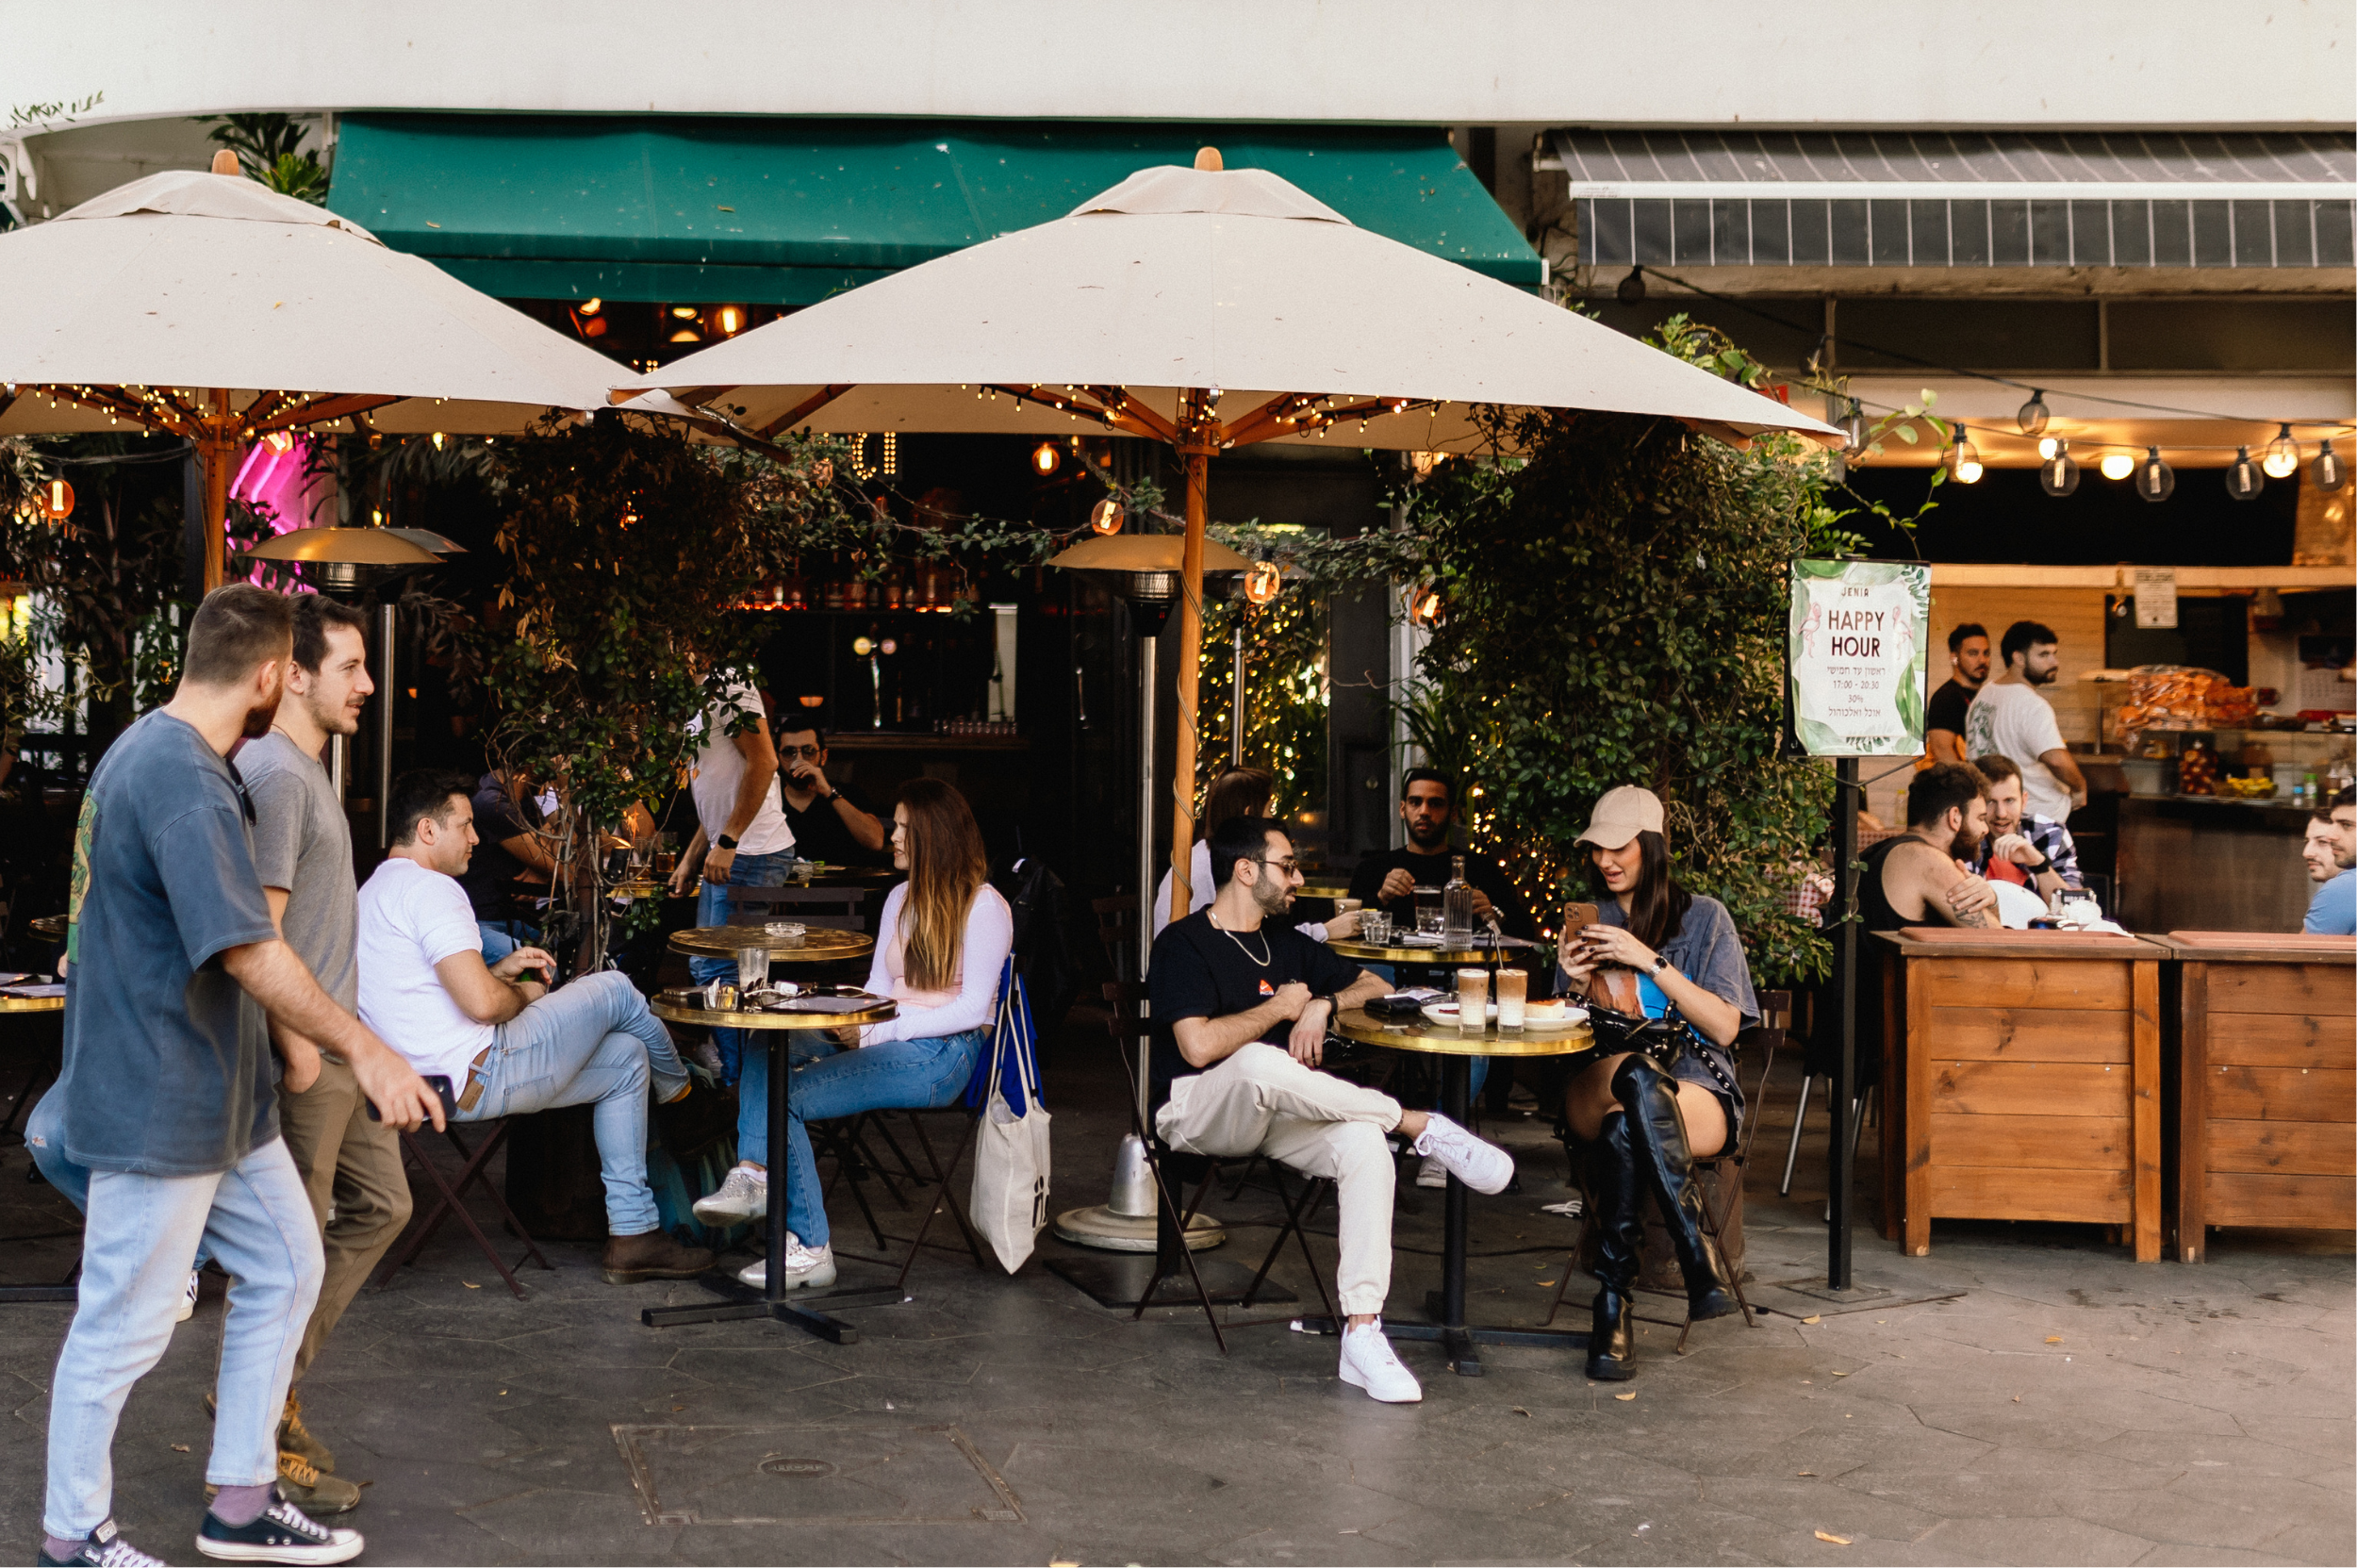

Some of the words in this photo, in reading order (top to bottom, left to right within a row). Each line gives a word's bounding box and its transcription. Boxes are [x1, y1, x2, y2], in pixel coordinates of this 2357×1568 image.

[1841, 586, 1869, 597] JENIA
[1828, 609, 1885, 632] HAPPY
[1831, 635, 1881, 657] HOUR
[1826, 666, 1851, 675] חמישי
[1853, 667, 1863, 676] עד
[1865, 667, 1886, 678] ראשון
[1833, 680, 1854, 689] 17:00
[1860, 680, 1880, 689] 20:30
[1848, 694, 1864, 703] 30%
[1828, 706, 1862, 717] ואלכוהול
[1864, 707, 1881, 717] אוכל
